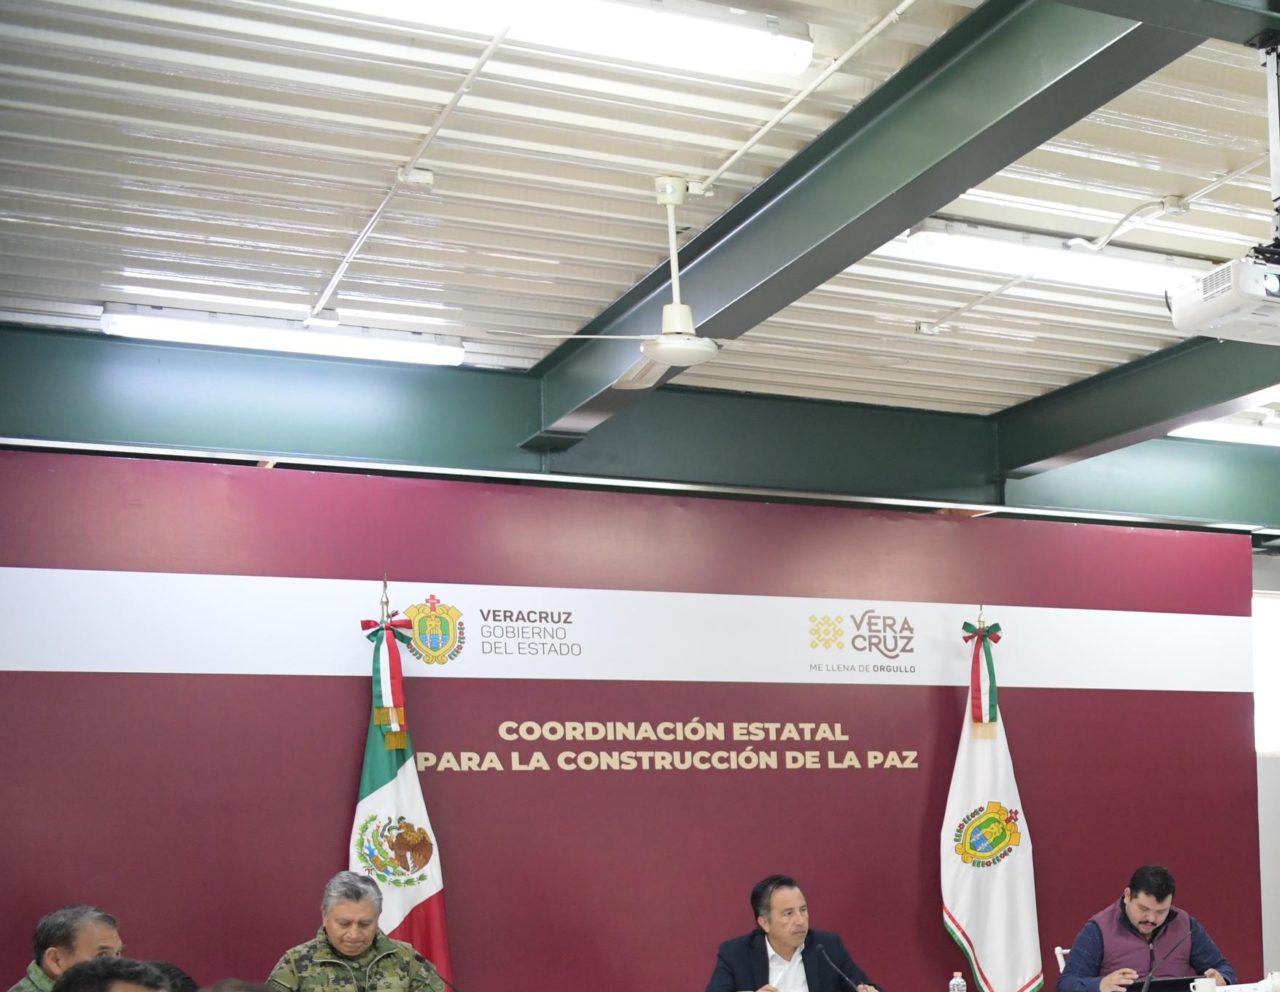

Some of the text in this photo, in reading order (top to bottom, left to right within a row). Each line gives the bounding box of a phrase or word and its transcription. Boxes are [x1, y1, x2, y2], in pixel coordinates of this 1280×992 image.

[480, 609, 573, 624] VERACRUZ
[850, 609, 914, 634] VERA
[480, 625, 567, 640] GOBIERNO
[481, 641, 582, 656] DEL ESTADO
[851, 634, 914, 659] CRUZ
[809, 664, 916, 673] ME LLENA DE ORGULLO
[498, 717, 849, 741] COORDINACIÓN ESTATAL
[416, 746, 919, 771] PARA LA CONSTRUCCIÓN DE LA PAZ
